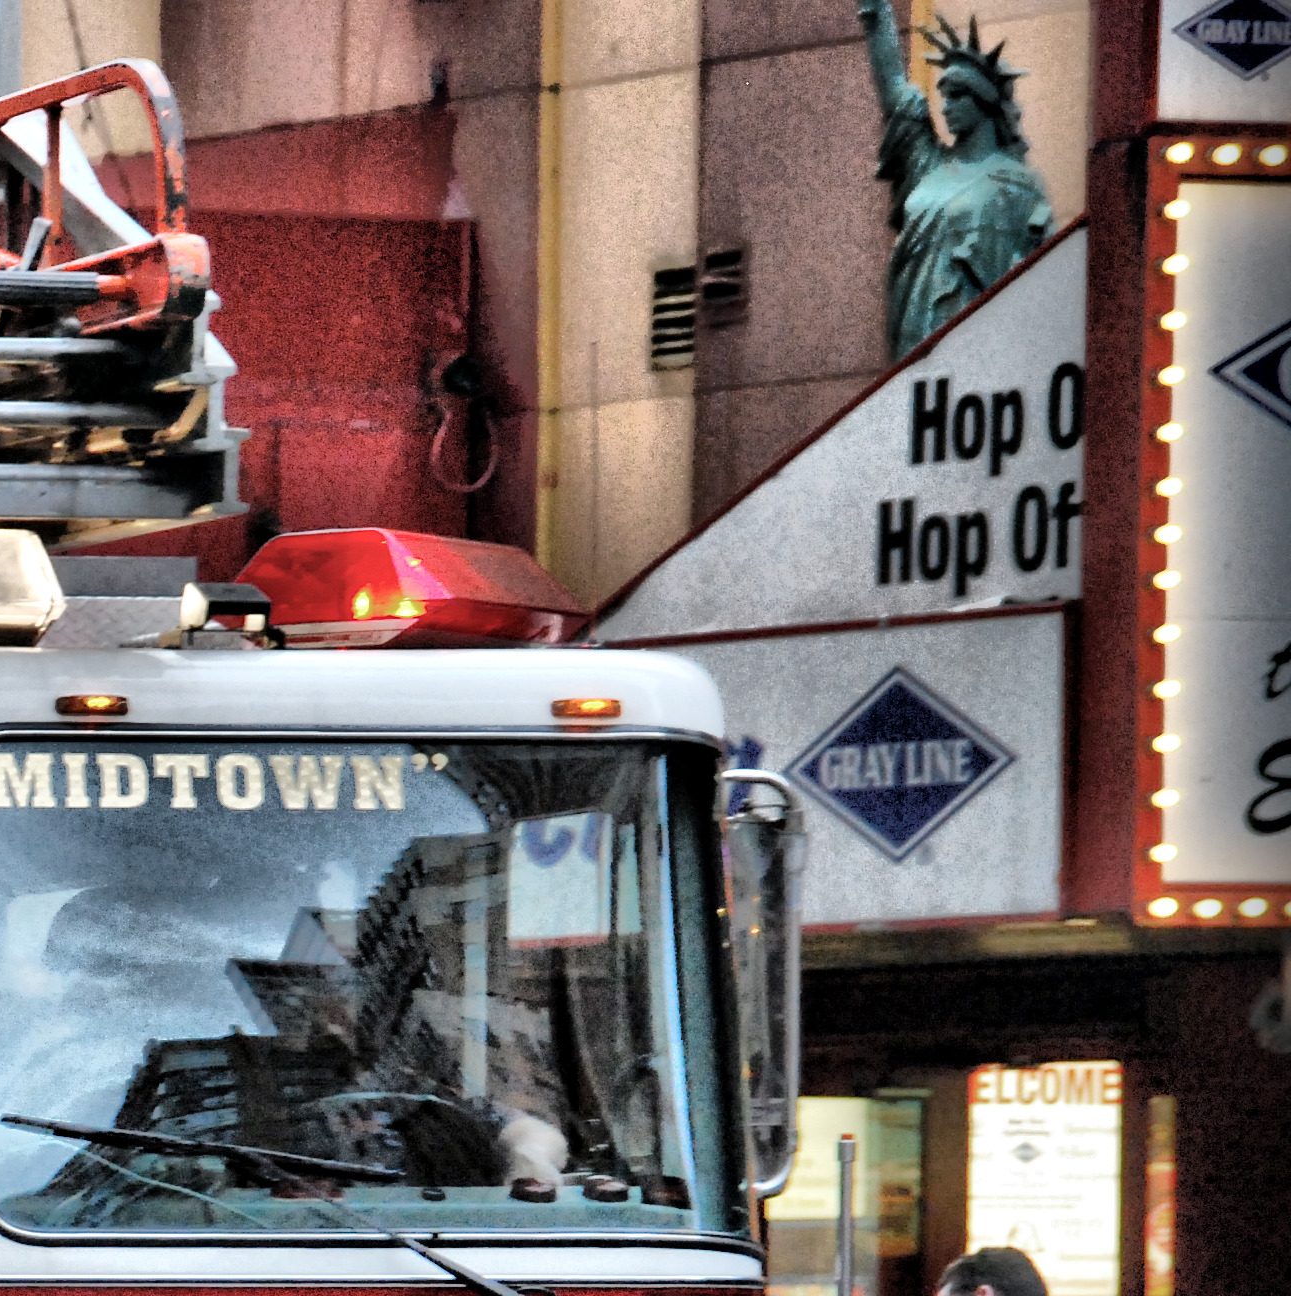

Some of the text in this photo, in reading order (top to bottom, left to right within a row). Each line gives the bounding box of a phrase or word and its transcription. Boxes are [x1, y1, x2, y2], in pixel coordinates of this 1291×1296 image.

[1197, 18, 1251, 45] GRAY
[910, 376, 1021, 475] Hop
[877, 497, 989, 597] Hop
[818, 738, 973, 791] GRAY LINE
